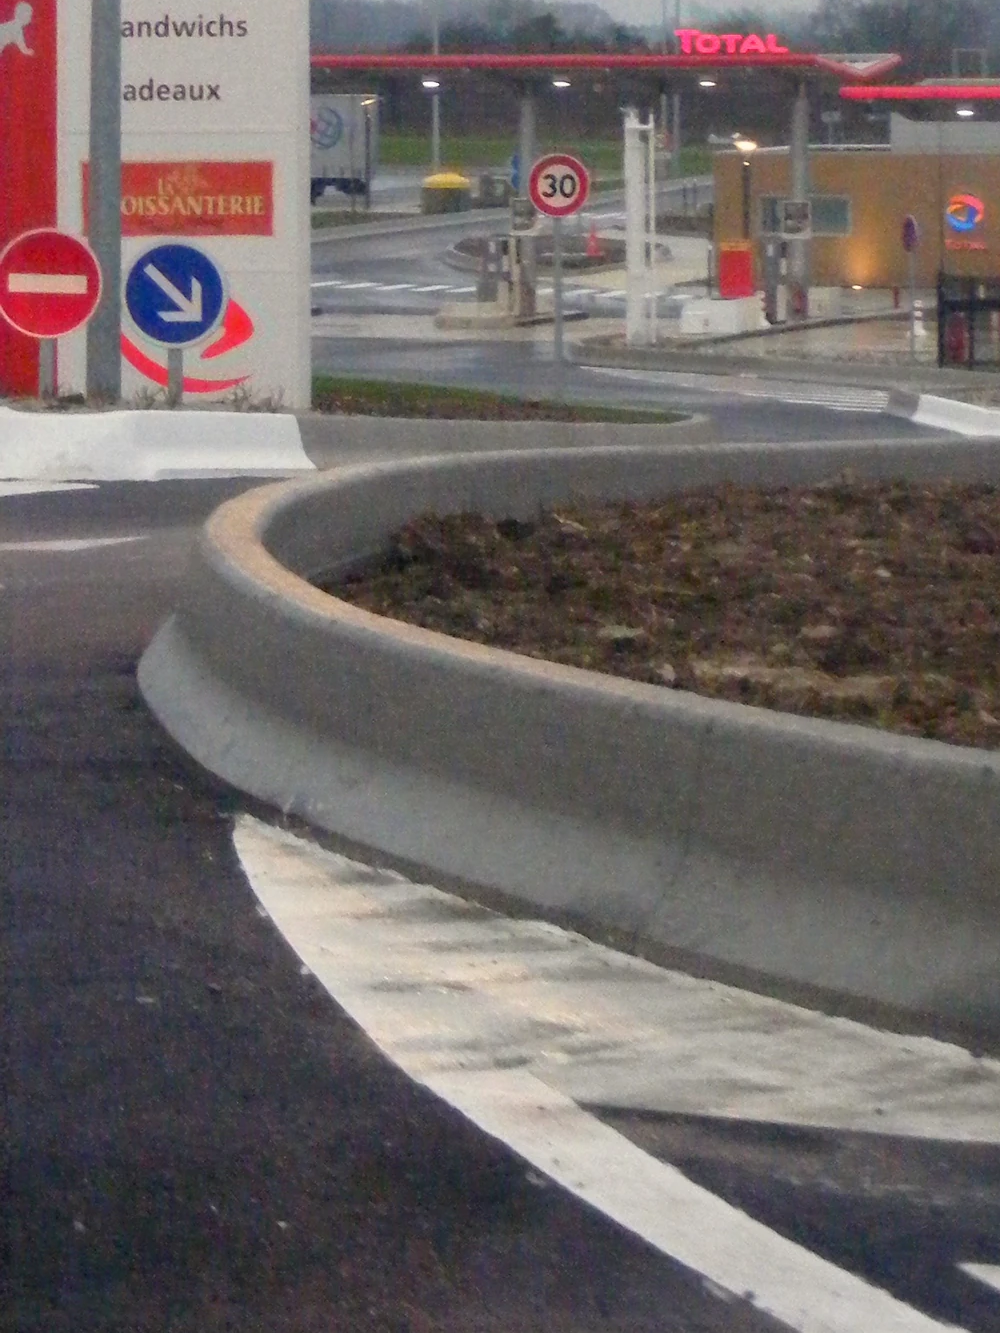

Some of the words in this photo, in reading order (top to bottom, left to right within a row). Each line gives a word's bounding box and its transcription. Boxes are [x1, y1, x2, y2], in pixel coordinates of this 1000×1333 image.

[121, 13, 248, 38] andwichs
[674, 28, 789, 54] TOTAL
[122, 78, 221, 102] adeaux
[541, 173, 577, 199] 30
[121, 194, 266, 217] OISSANTERIE
